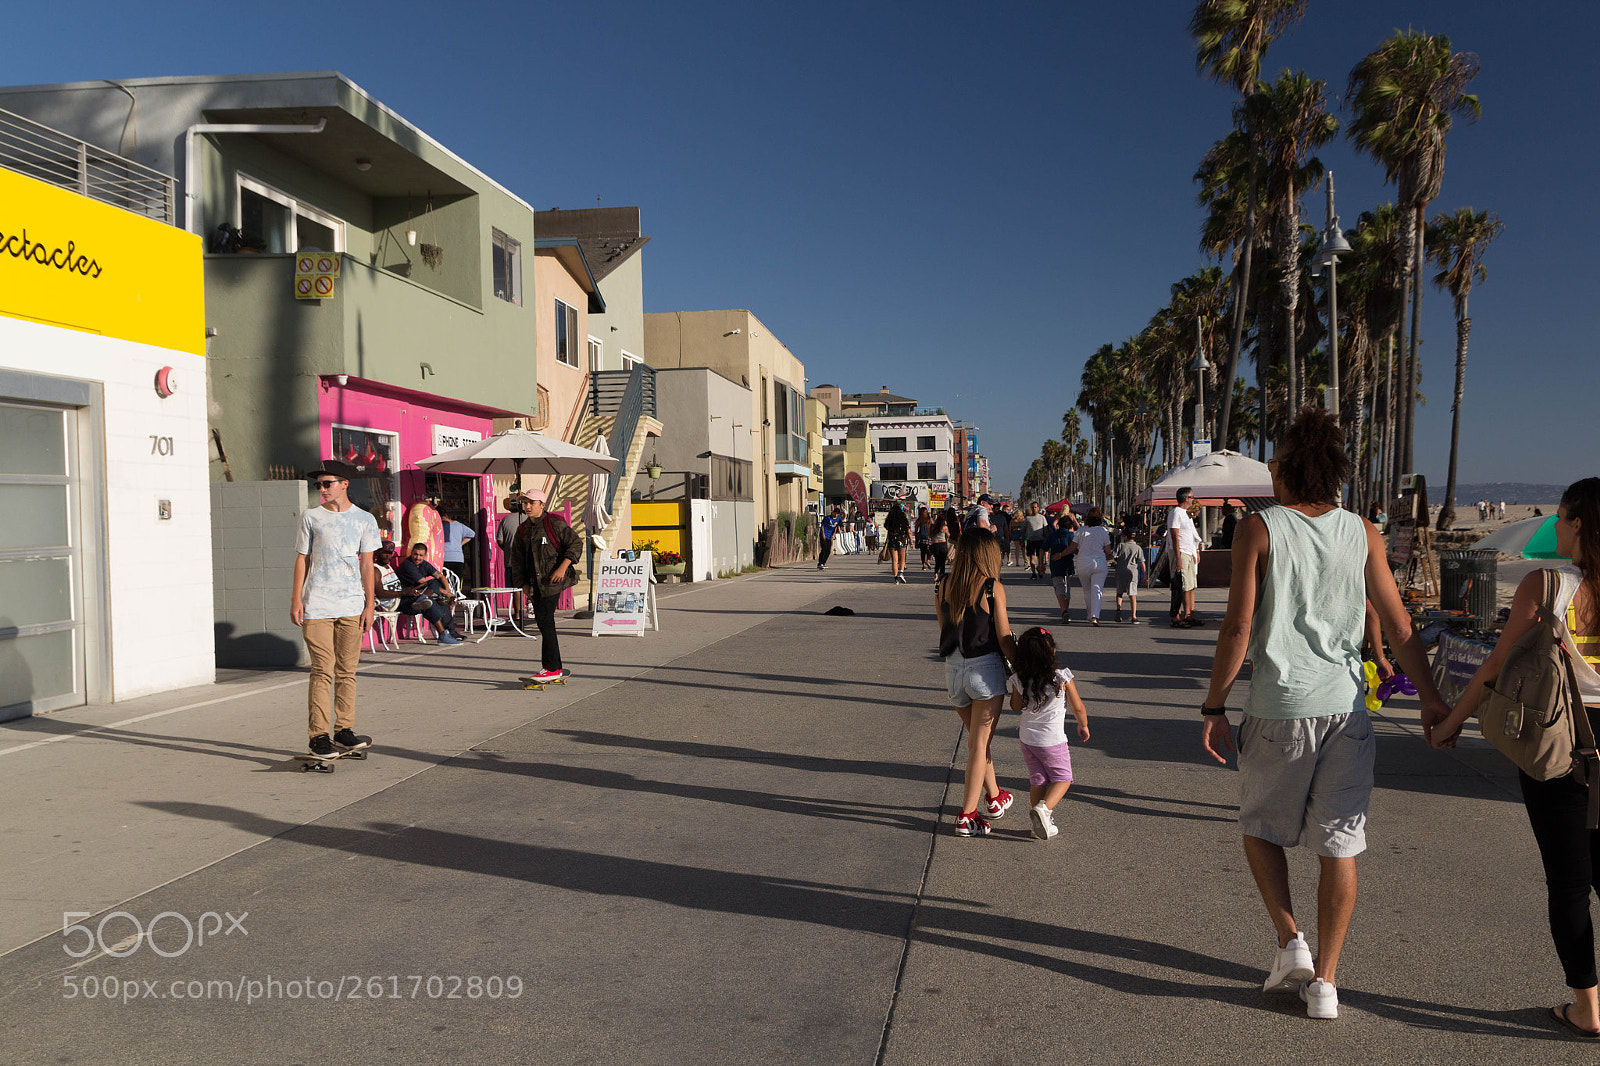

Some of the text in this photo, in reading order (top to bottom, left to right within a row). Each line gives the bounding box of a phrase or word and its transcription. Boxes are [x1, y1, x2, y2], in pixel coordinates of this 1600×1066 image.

[149, 435, 174, 456] 701
[442, 435, 459, 448] PHONE
[601, 565, 644, 575] PHONE
[601, 578, 642, 588] REPAIR
